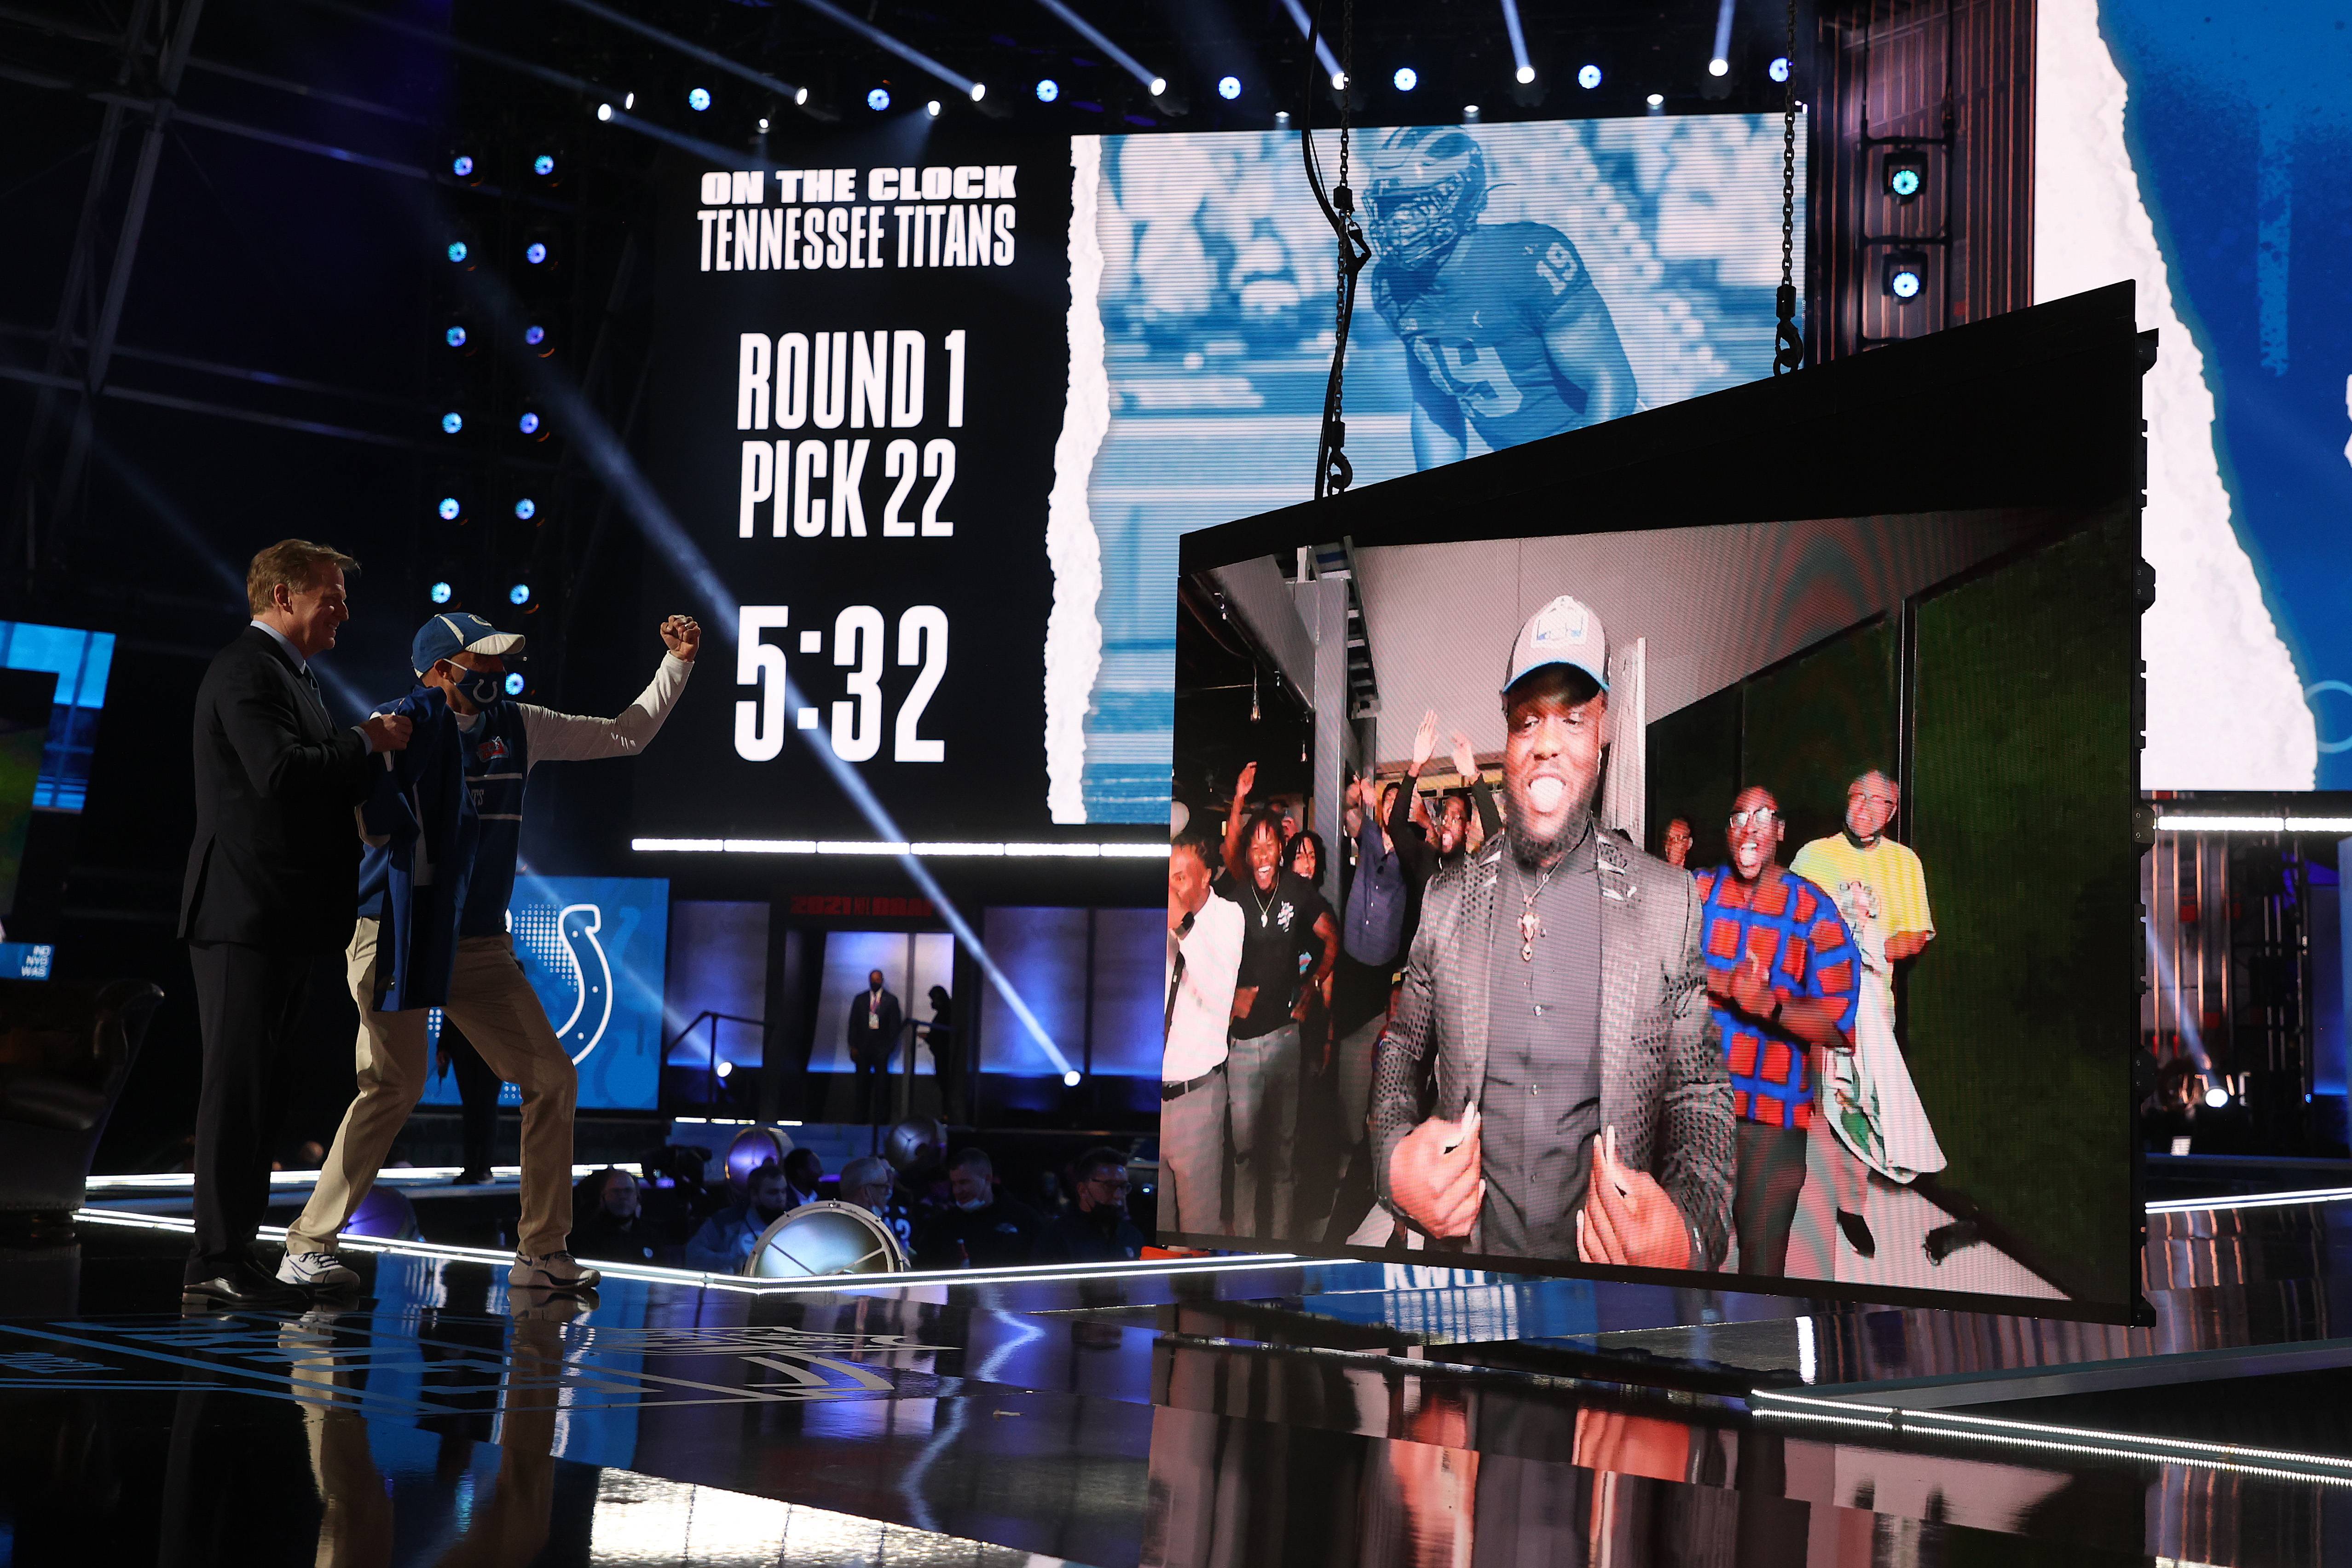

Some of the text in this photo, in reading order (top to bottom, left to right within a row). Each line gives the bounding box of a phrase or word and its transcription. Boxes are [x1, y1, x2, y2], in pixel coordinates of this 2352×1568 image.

[701, 165, 1017, 205] ON THE CLOCK
[697, 204, 1016, 272] TENNESSEE TITANS
[1536, 242, 1578, 295] 19
[737, 330, 966, 430] ROUND 1
[739, 439, 956, 538] PICK 22
[734, 605, 949, 763] 5:32
